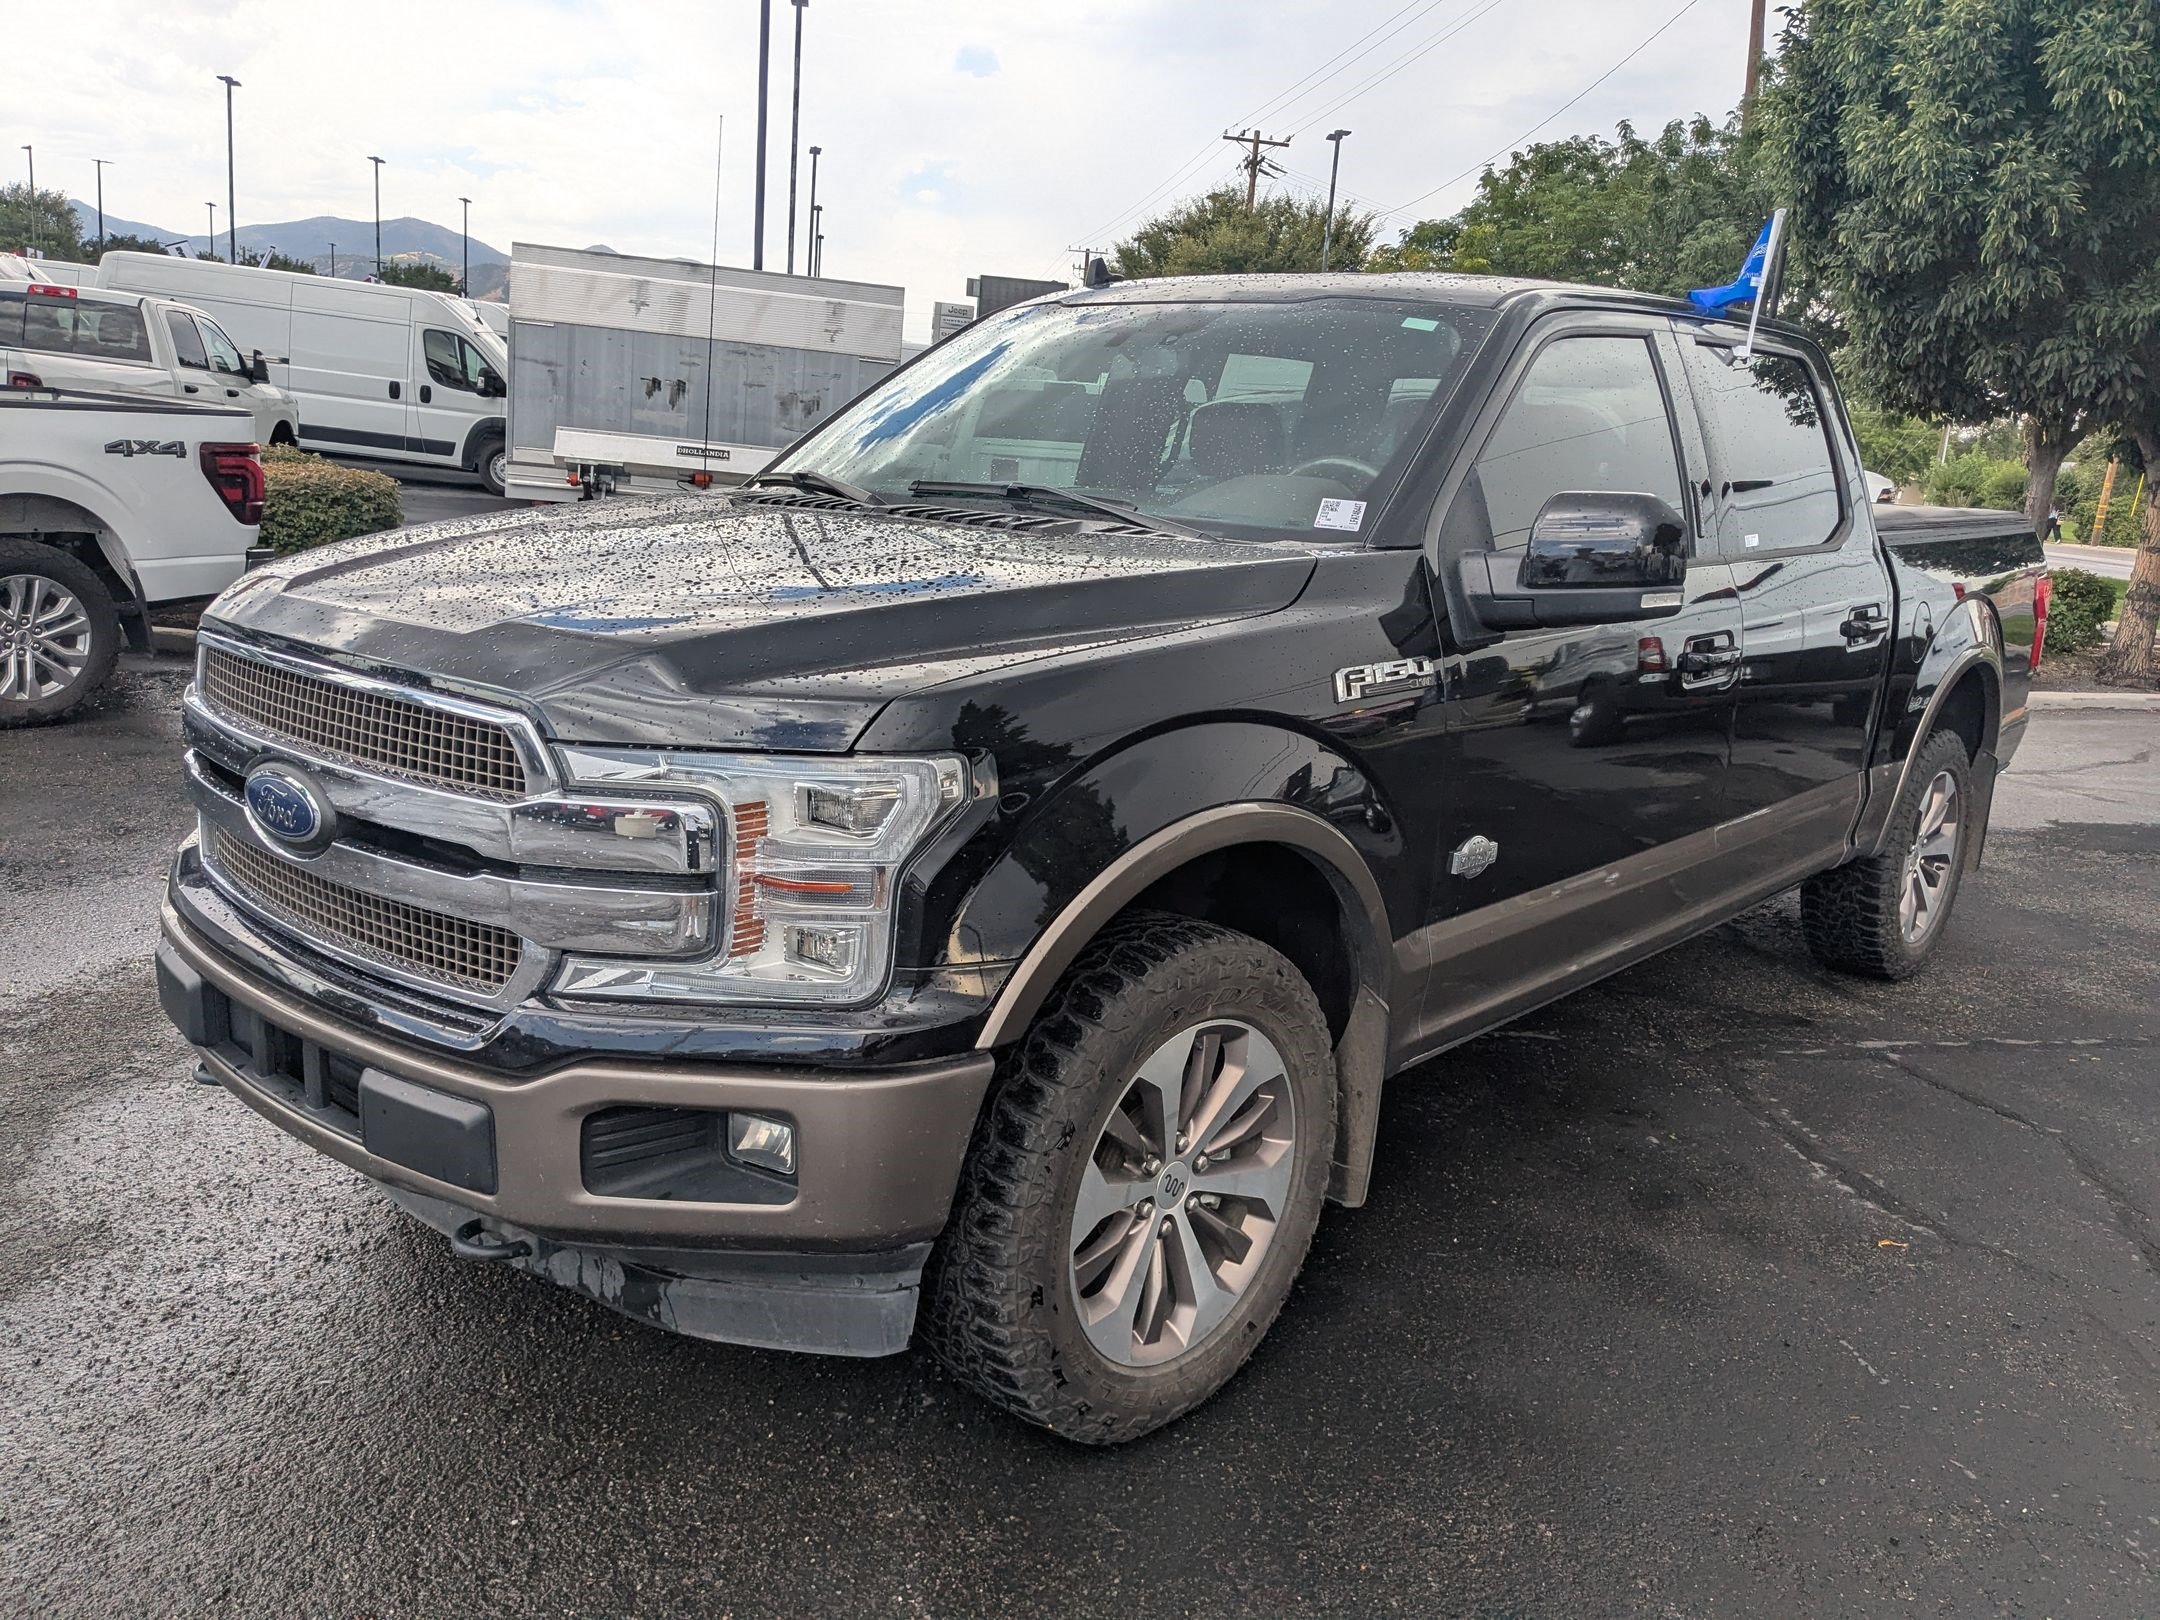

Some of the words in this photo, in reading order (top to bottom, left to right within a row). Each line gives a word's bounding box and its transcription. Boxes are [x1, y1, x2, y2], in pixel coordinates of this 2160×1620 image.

[948, 306, 968, 316] Jeep
[677, 446, 729, 459] DHOLLANDIA
[257, 783, 299, 829] Ford
